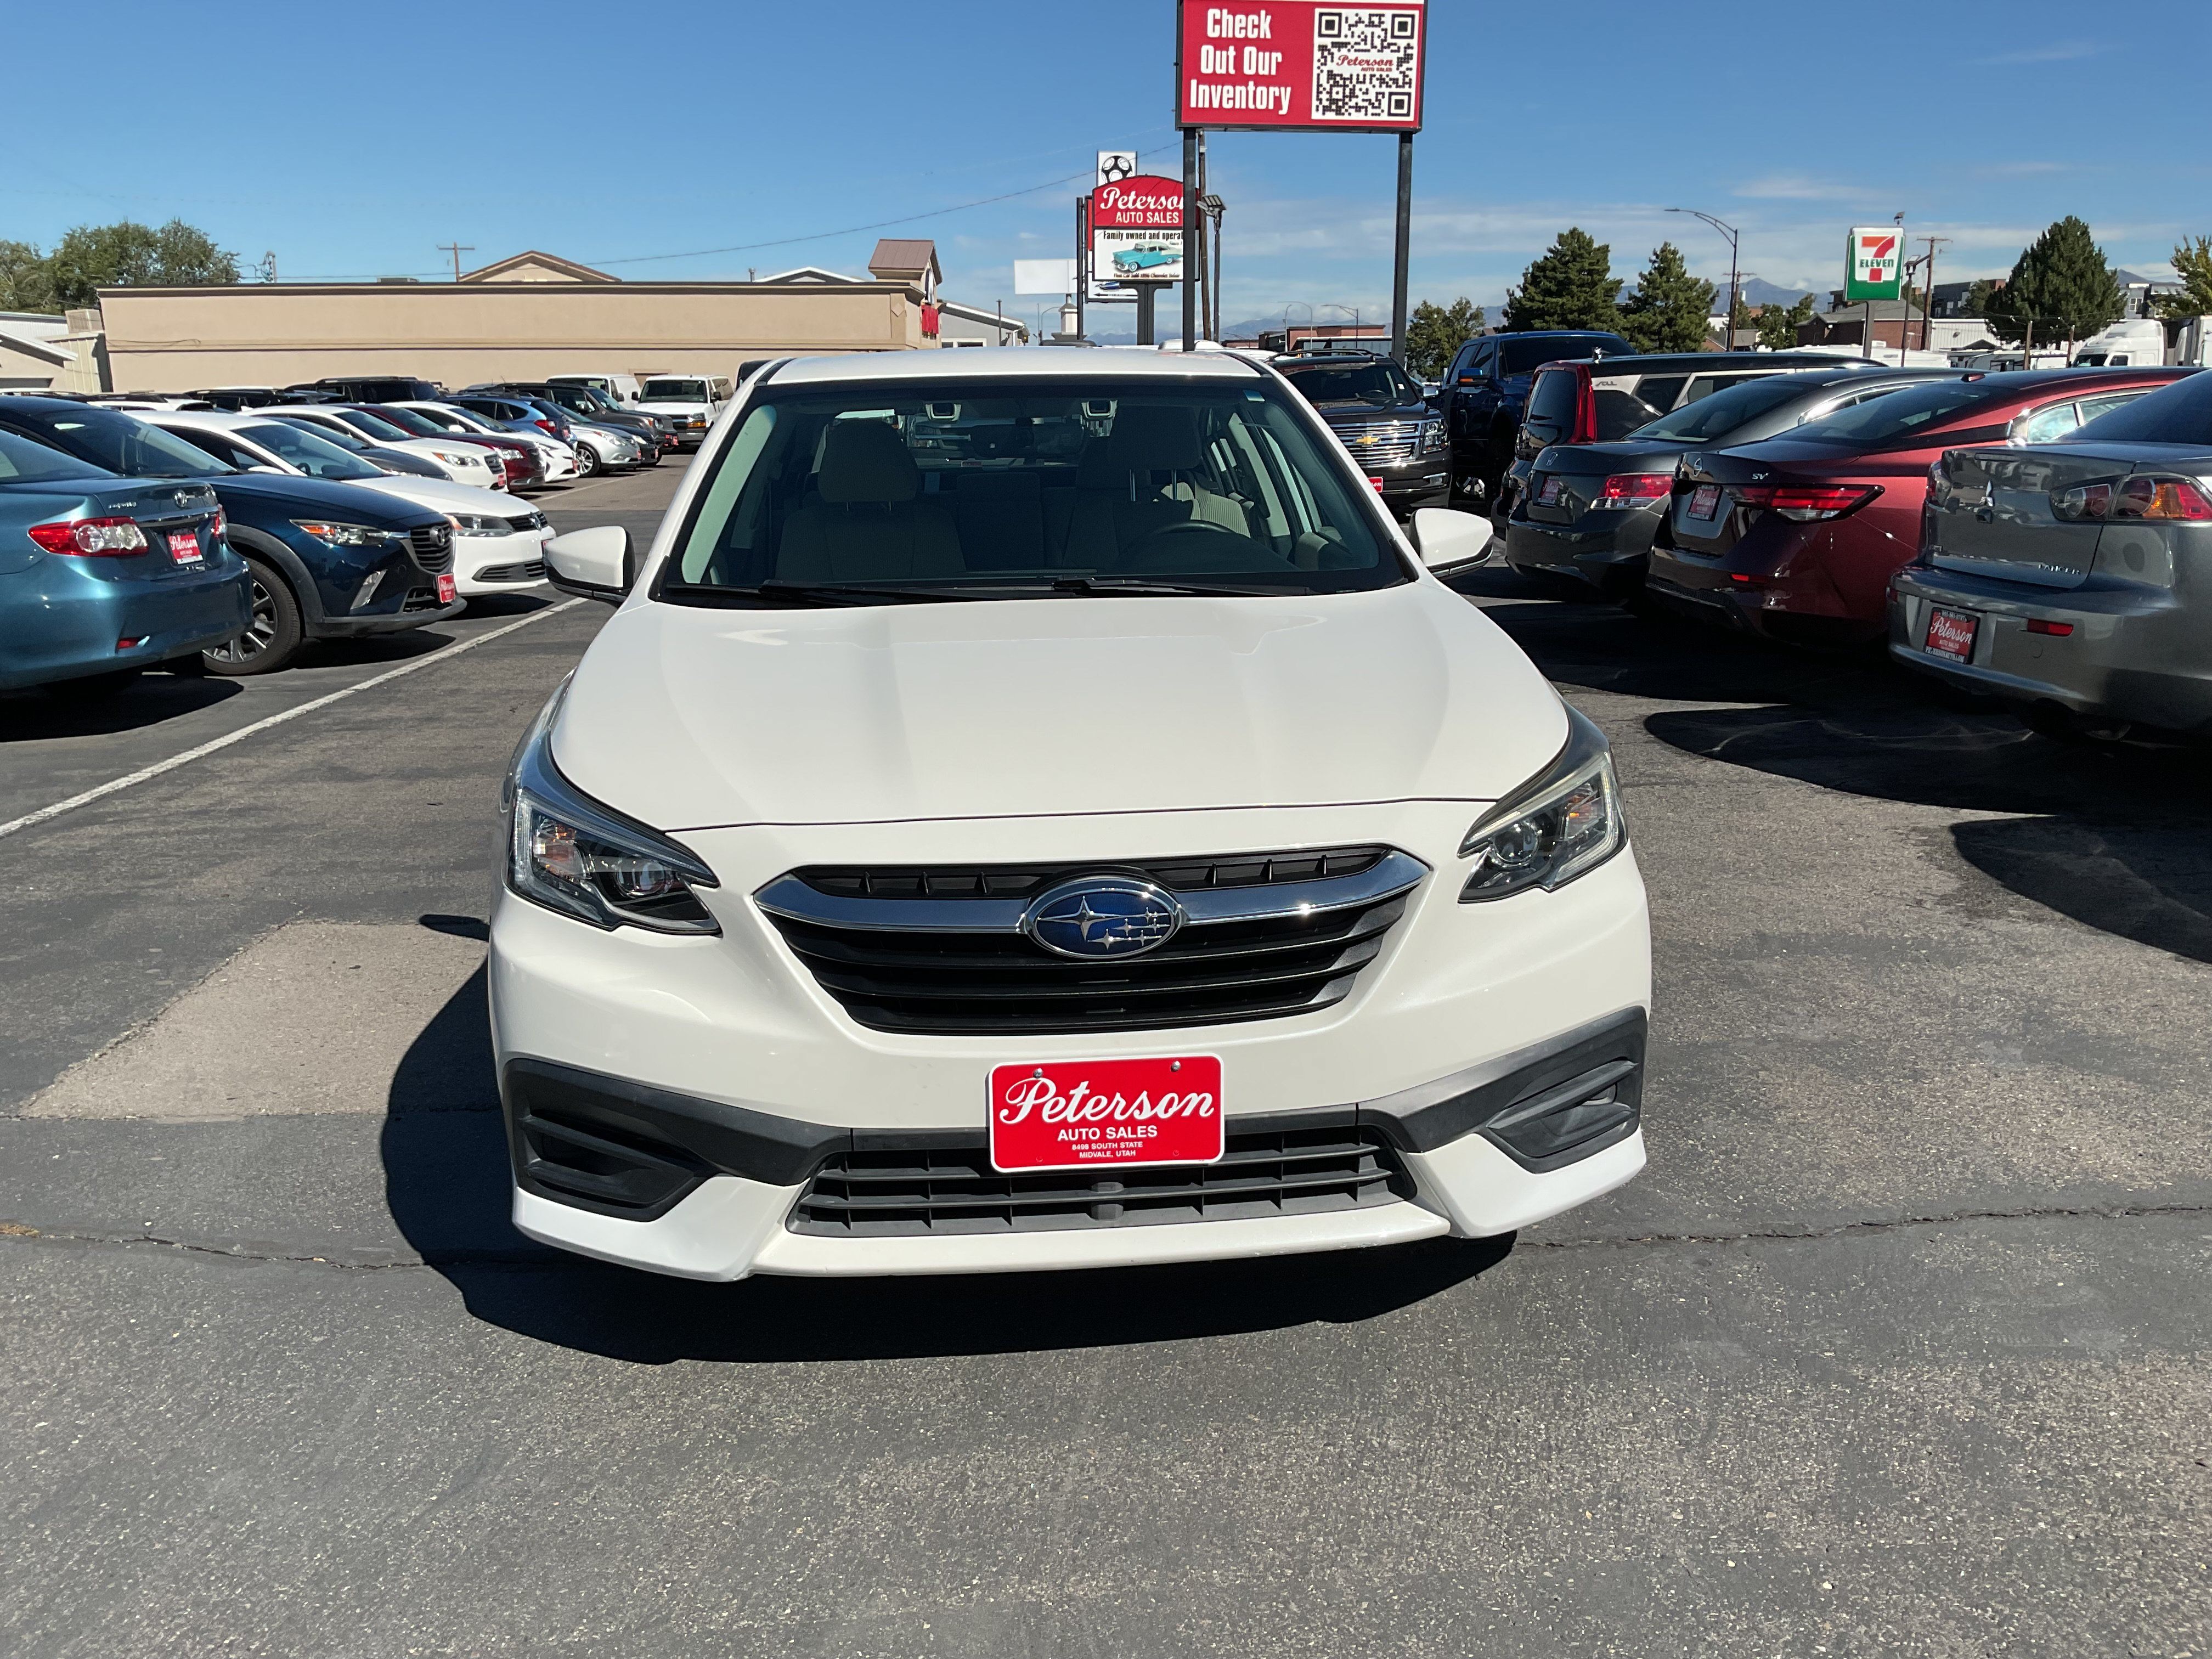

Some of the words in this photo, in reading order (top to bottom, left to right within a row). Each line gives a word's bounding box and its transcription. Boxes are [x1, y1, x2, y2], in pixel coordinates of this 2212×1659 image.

[1206, 8, 1272, 39] Check
[1200, 45, 1236, 75] Out
[1243, 46, 1282, 75] Our
[1336, 54, 1393, 66] Peterson
[1190, 79, 1291, 115] Inventory
[1115, 211, 1143, 223] AUTO
[1147, 211, 1179, 224] SALES
[1103, 230, 1124, 241] Family
[1126, 231, 1147, 240] owned
[1148, 231, 1160, 240] and
[1861, 235, 1895, 282] 7
[1930, 616, 1972, 645] Peterson
[1000, 1077, 1215, 1124] Peterson
[1057, 1127, 1101, 1142] AUTO
[1106, 1125, 1158, 1139] SALES
